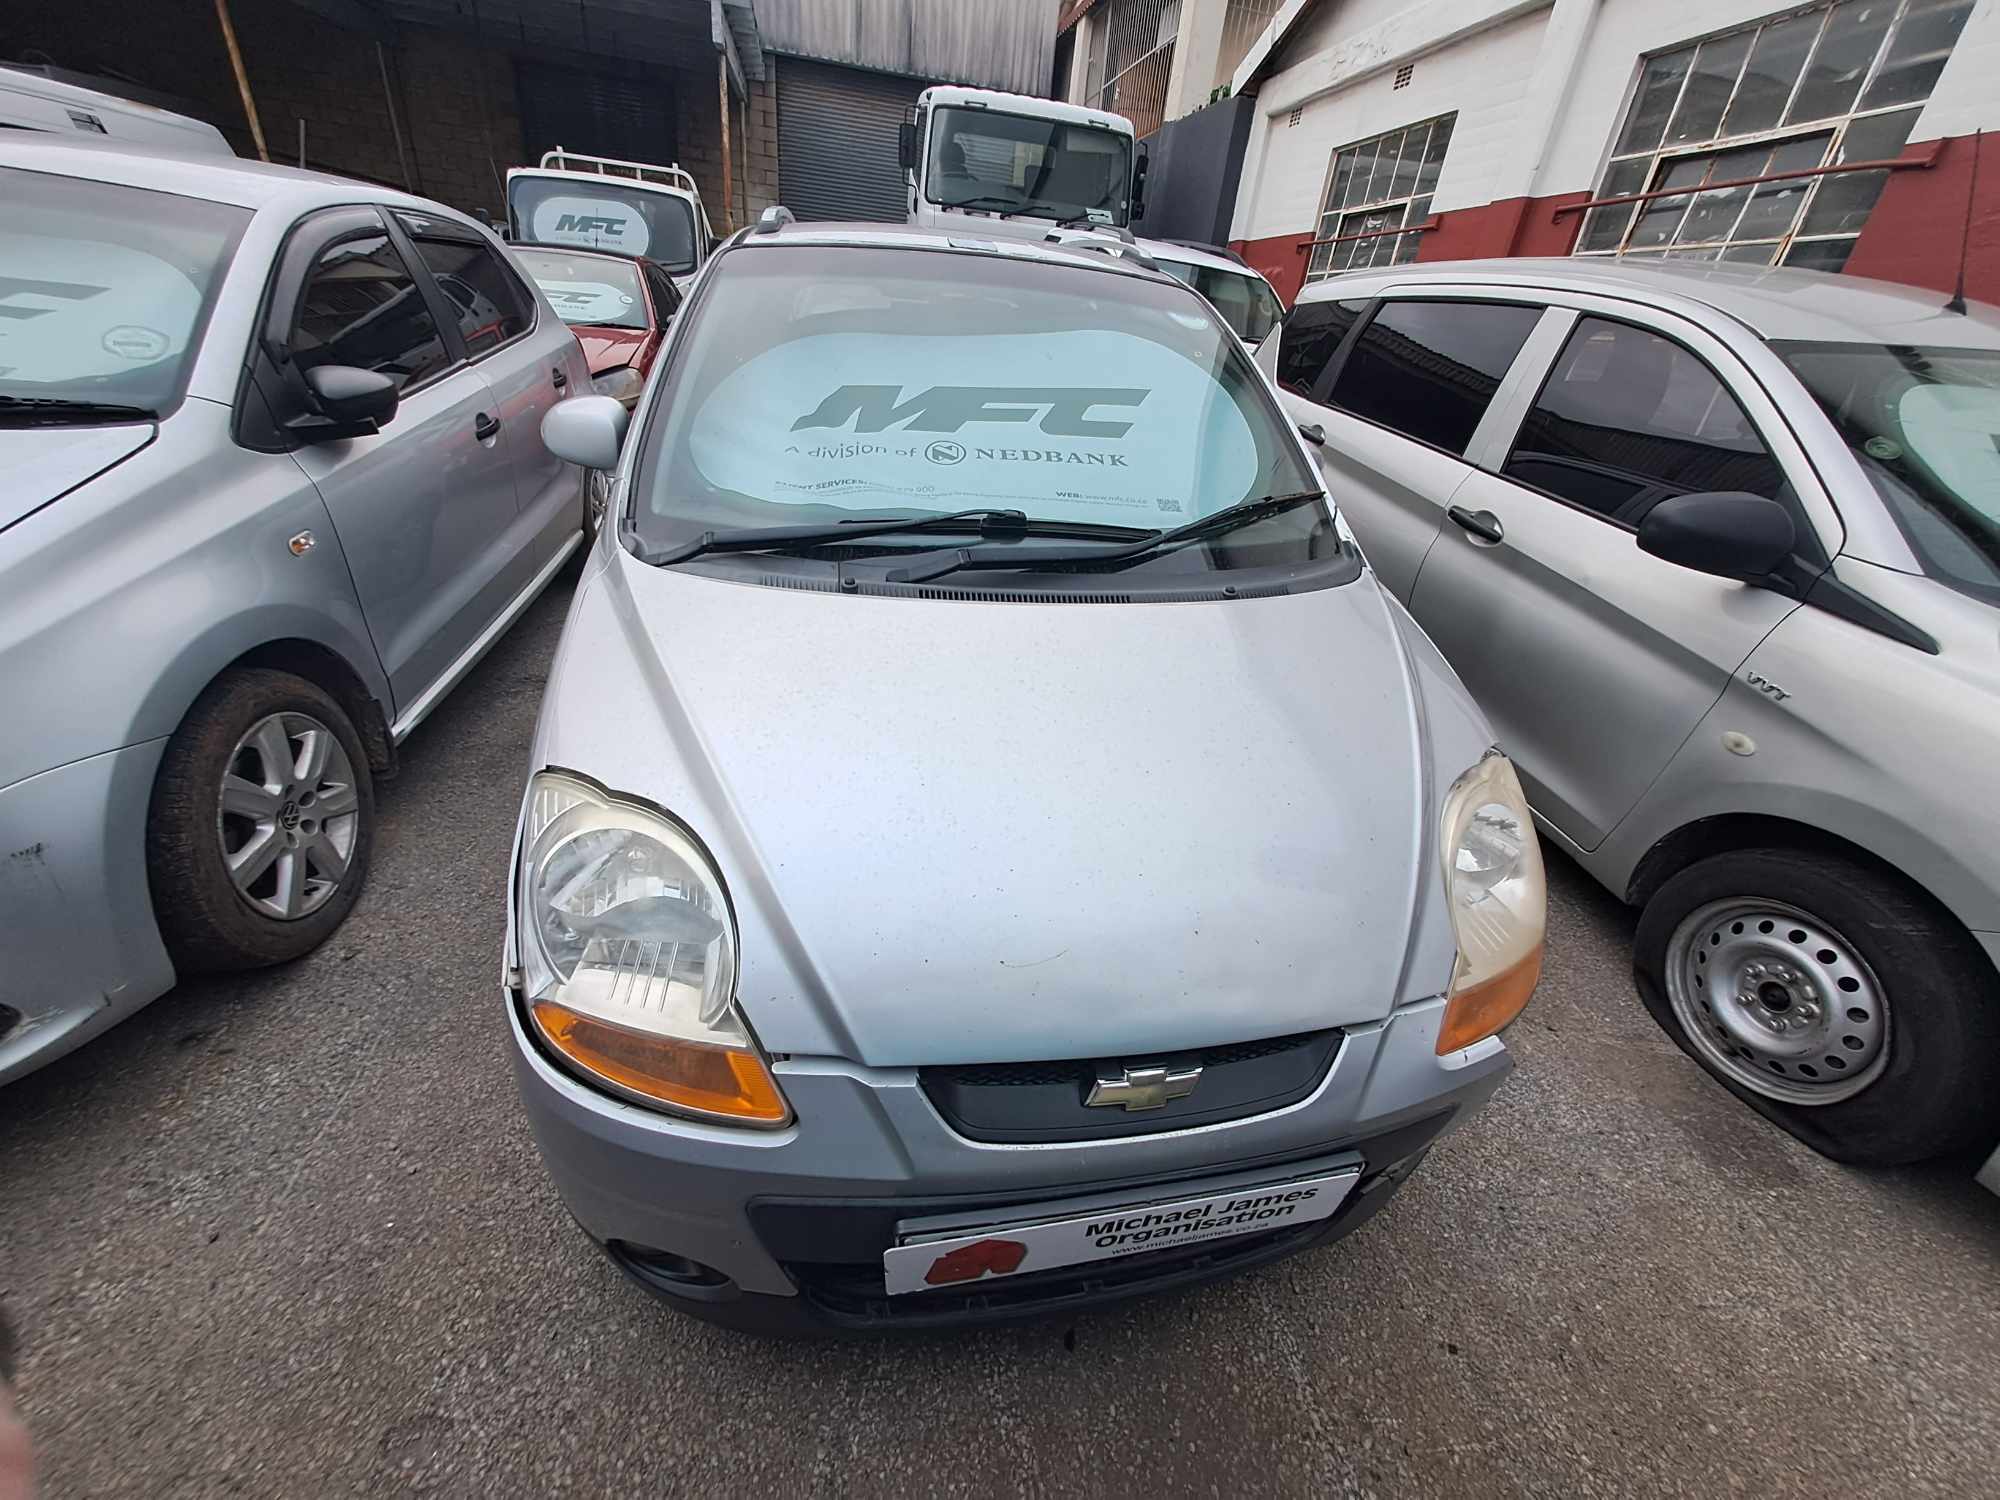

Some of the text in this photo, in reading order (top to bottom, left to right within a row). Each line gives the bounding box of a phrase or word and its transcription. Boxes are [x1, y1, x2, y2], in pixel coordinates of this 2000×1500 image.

[555, 214, 627, 235] MFC
[789, 384, 1153, 439] MFC
[784, 445, 800, 455] A
[807, 439, 888, 460] division
[894, 446, 917, 458] of
[974, 447, 1129, 468] NEDBANK
[1747, 671, 1792, 701] VVT
[1084, 1187, 1319, 1237] Michael James
[1094, 1203, 1297, 1248] Organisation
